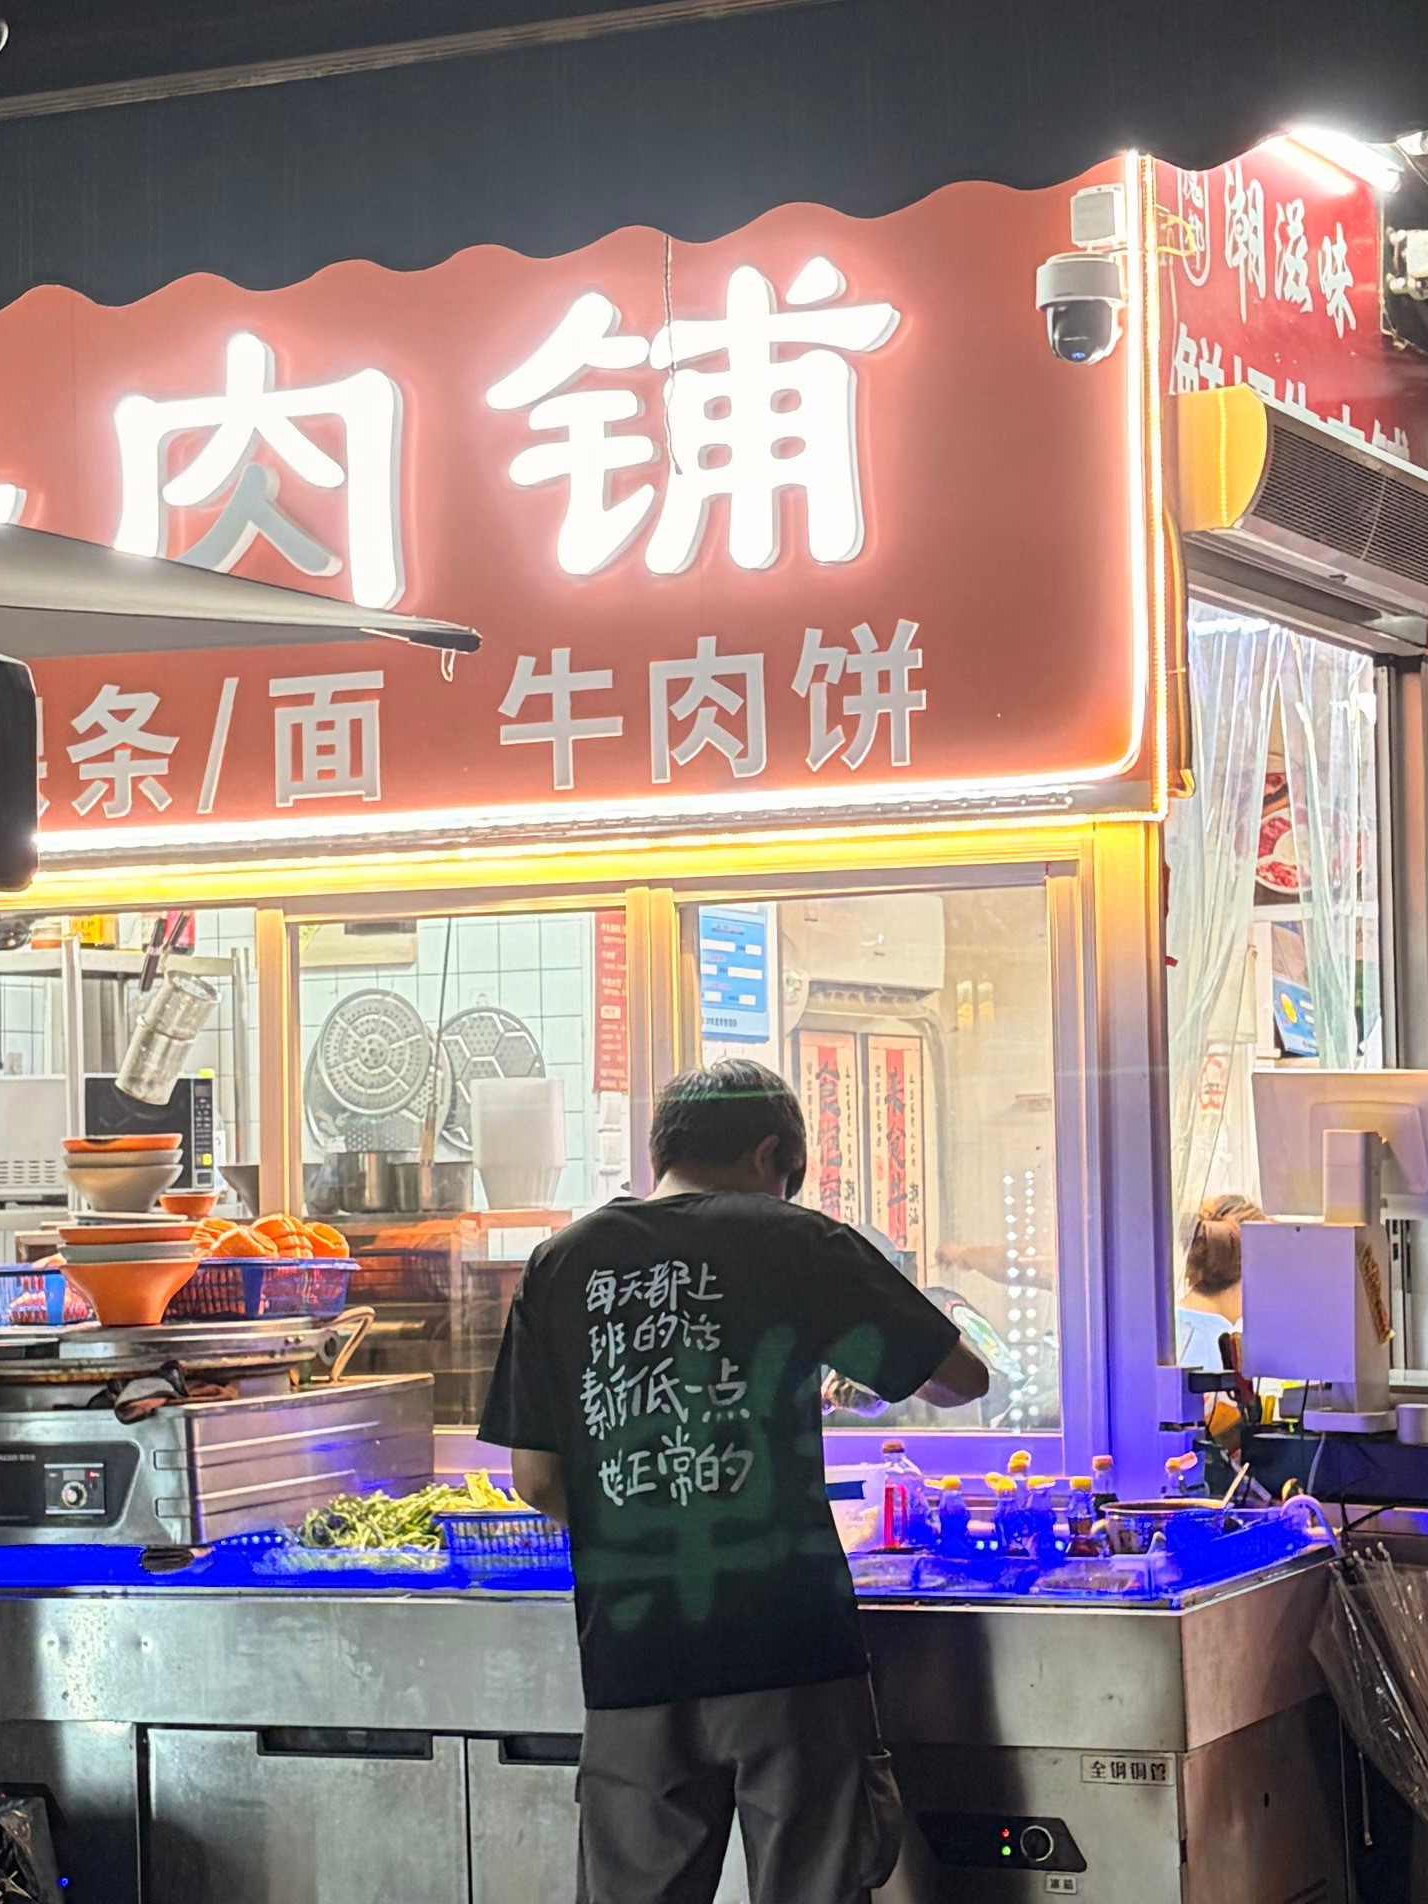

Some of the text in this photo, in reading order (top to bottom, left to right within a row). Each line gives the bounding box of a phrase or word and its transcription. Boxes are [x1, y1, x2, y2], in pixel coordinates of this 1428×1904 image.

[497, 618, 930, 789] 牛肉饼
[585, 1260, 724, 1314] 每天都上
[587, 1311, 721, 1368] 班的话
[580, 1358, 750, 1440] 素质低一点
[598, 1425, 754, 1506] 也正常的
